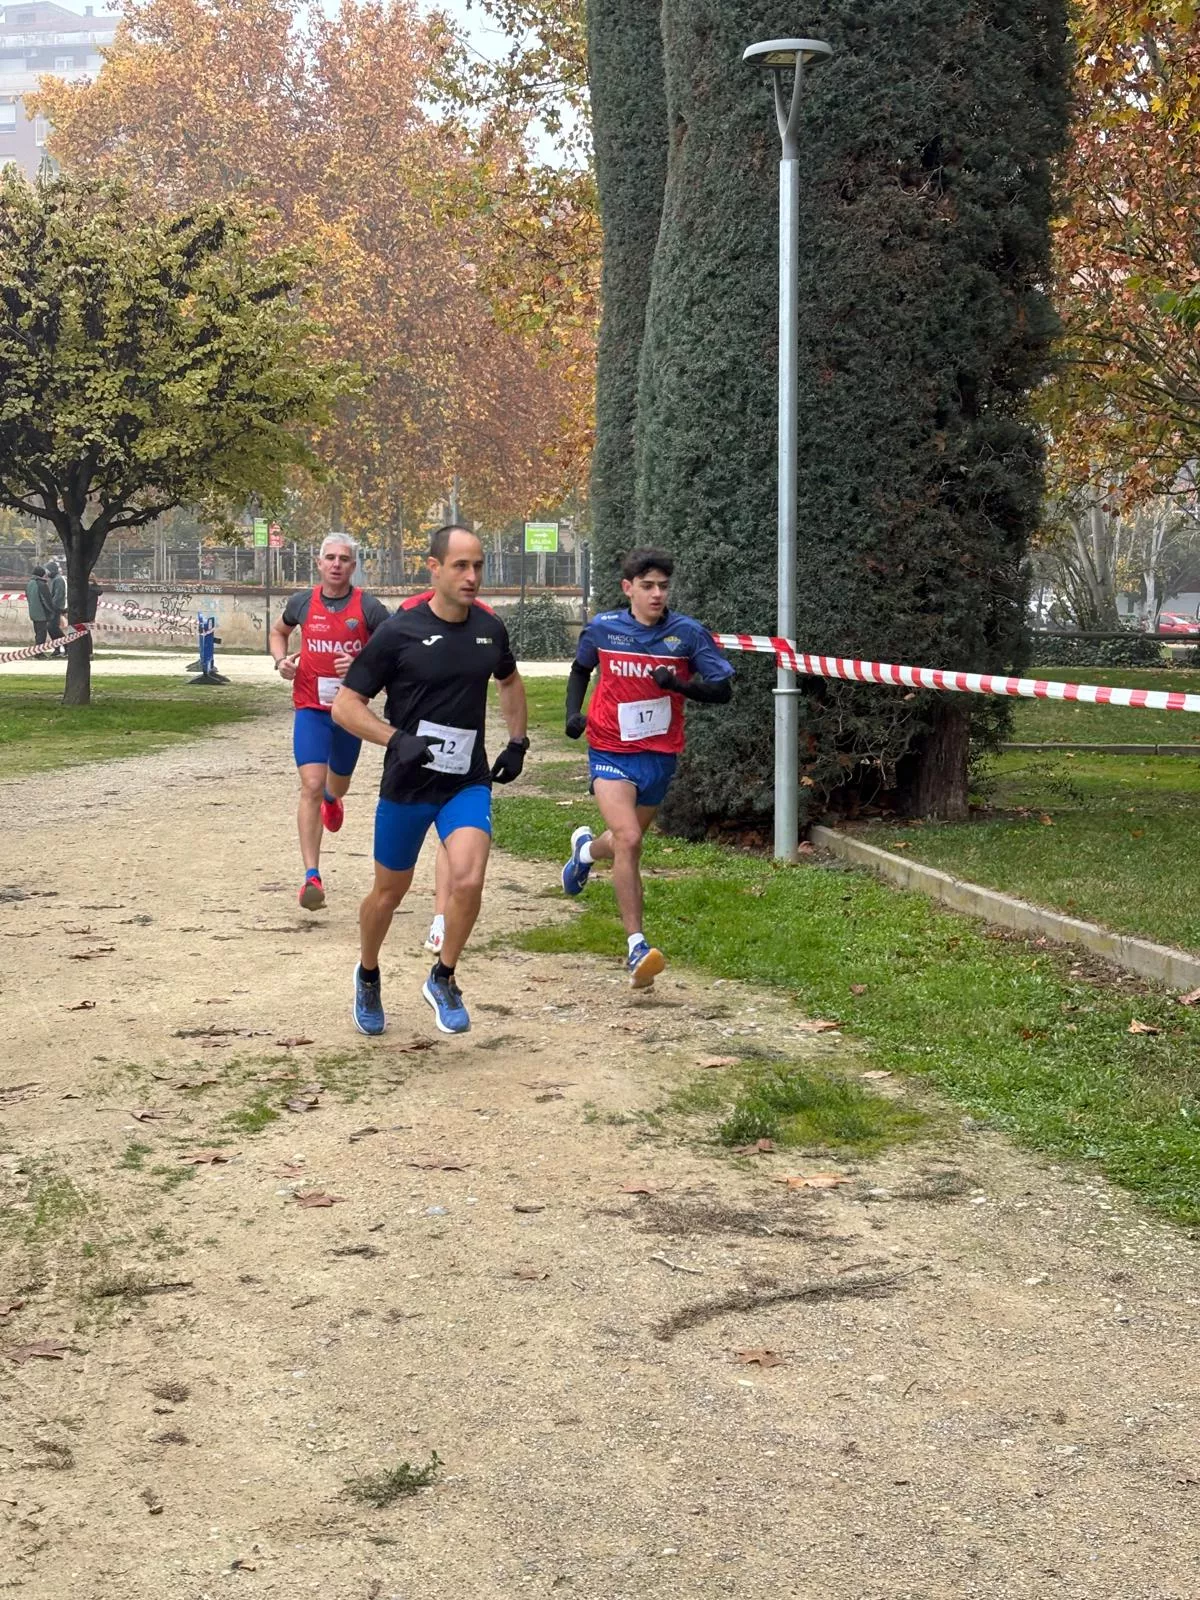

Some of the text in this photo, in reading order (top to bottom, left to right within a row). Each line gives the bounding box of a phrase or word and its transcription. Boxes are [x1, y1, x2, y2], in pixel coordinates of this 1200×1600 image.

[306, 638, 362, 653] HINACO
[639, 710, 654, 723] 17
[439, 740, 456, 754] 12
